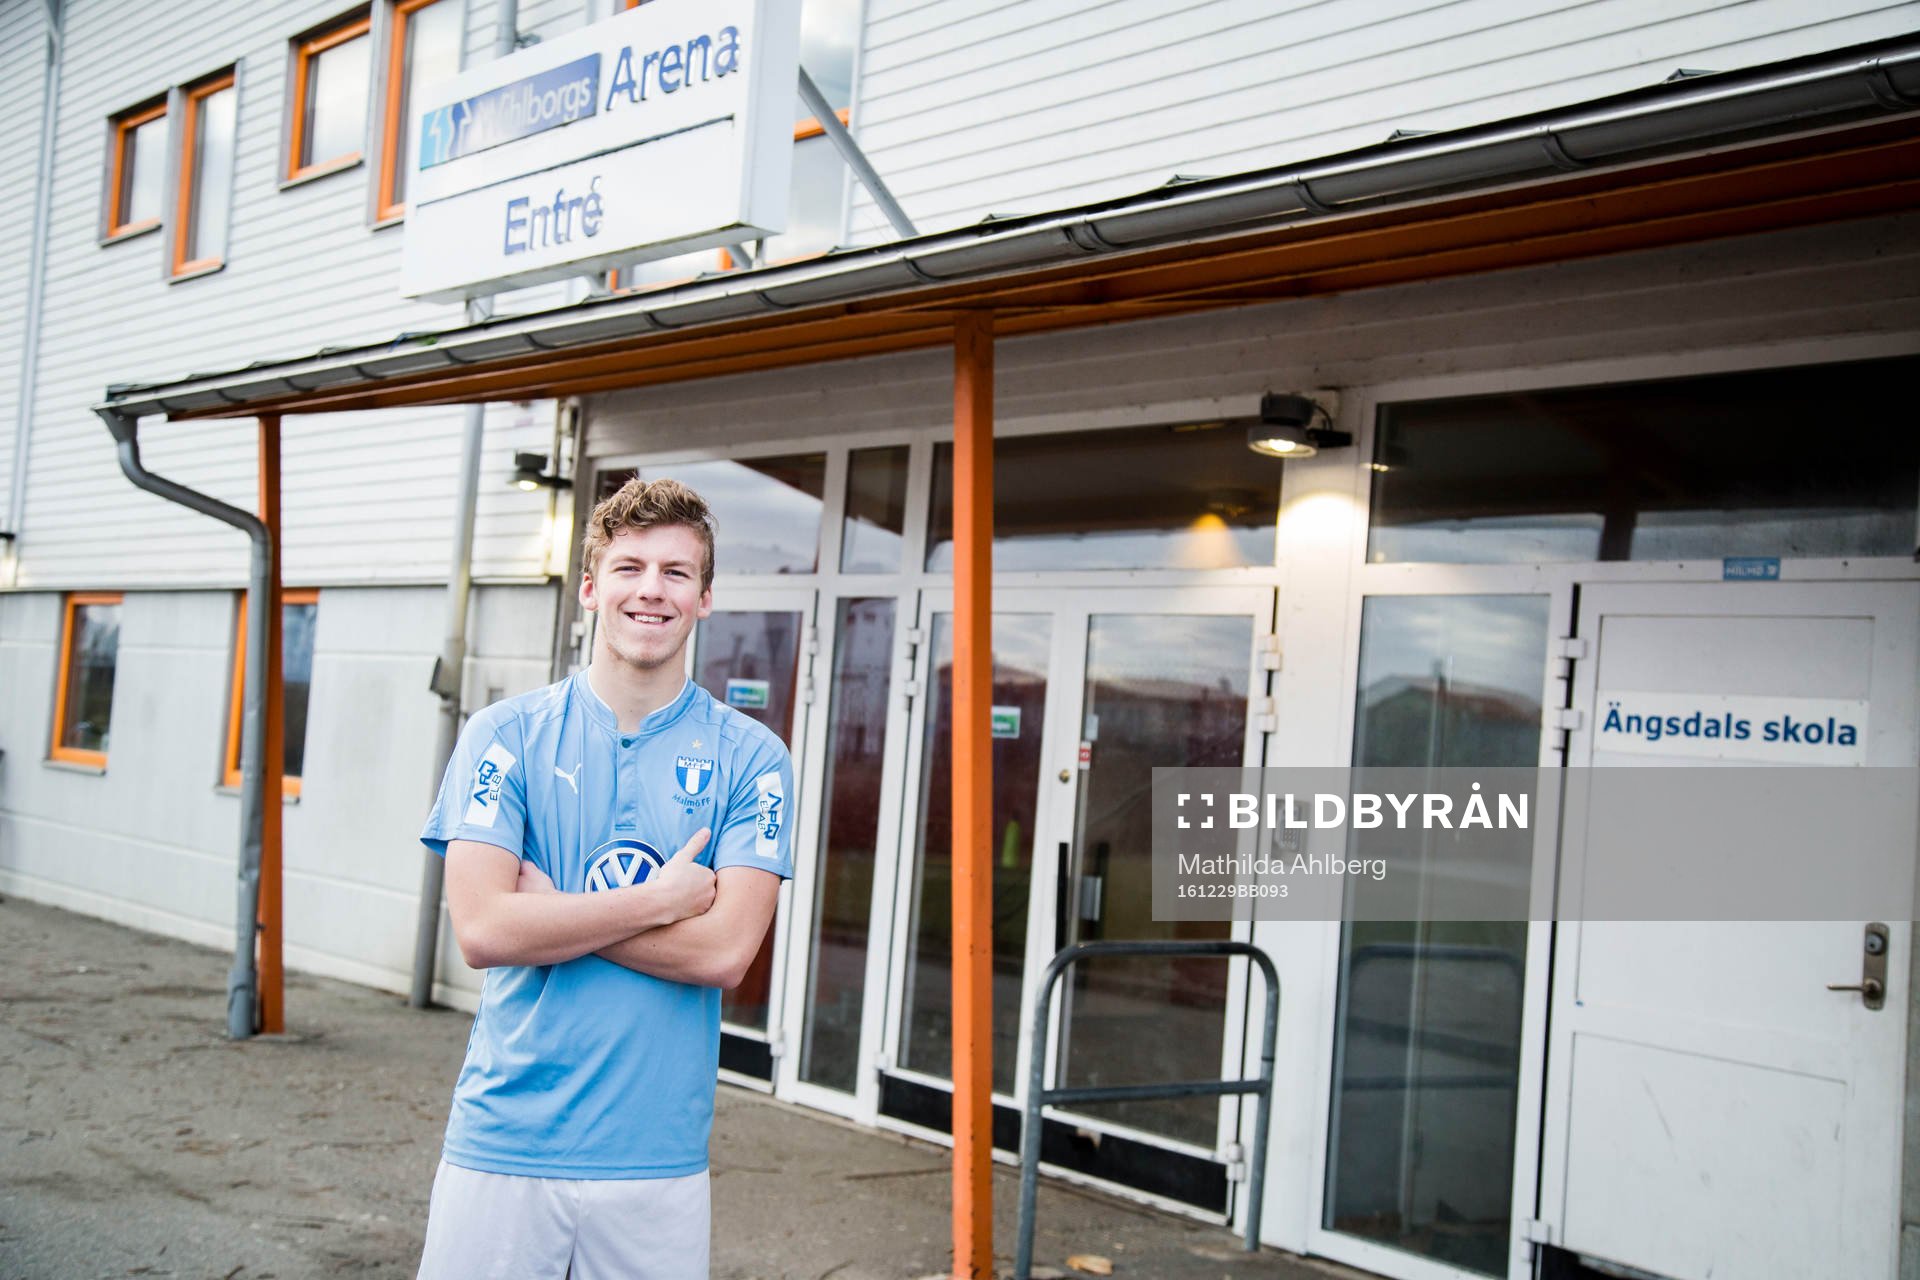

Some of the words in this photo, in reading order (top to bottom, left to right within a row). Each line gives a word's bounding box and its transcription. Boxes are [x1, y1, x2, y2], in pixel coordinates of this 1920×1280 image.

[607, 26, 739, 110] Arena
[504, 176, 603, 256] Entré
[1603, 701, 1751, 741] Ängsdals
[1763, 716, 1858, 746] skola
